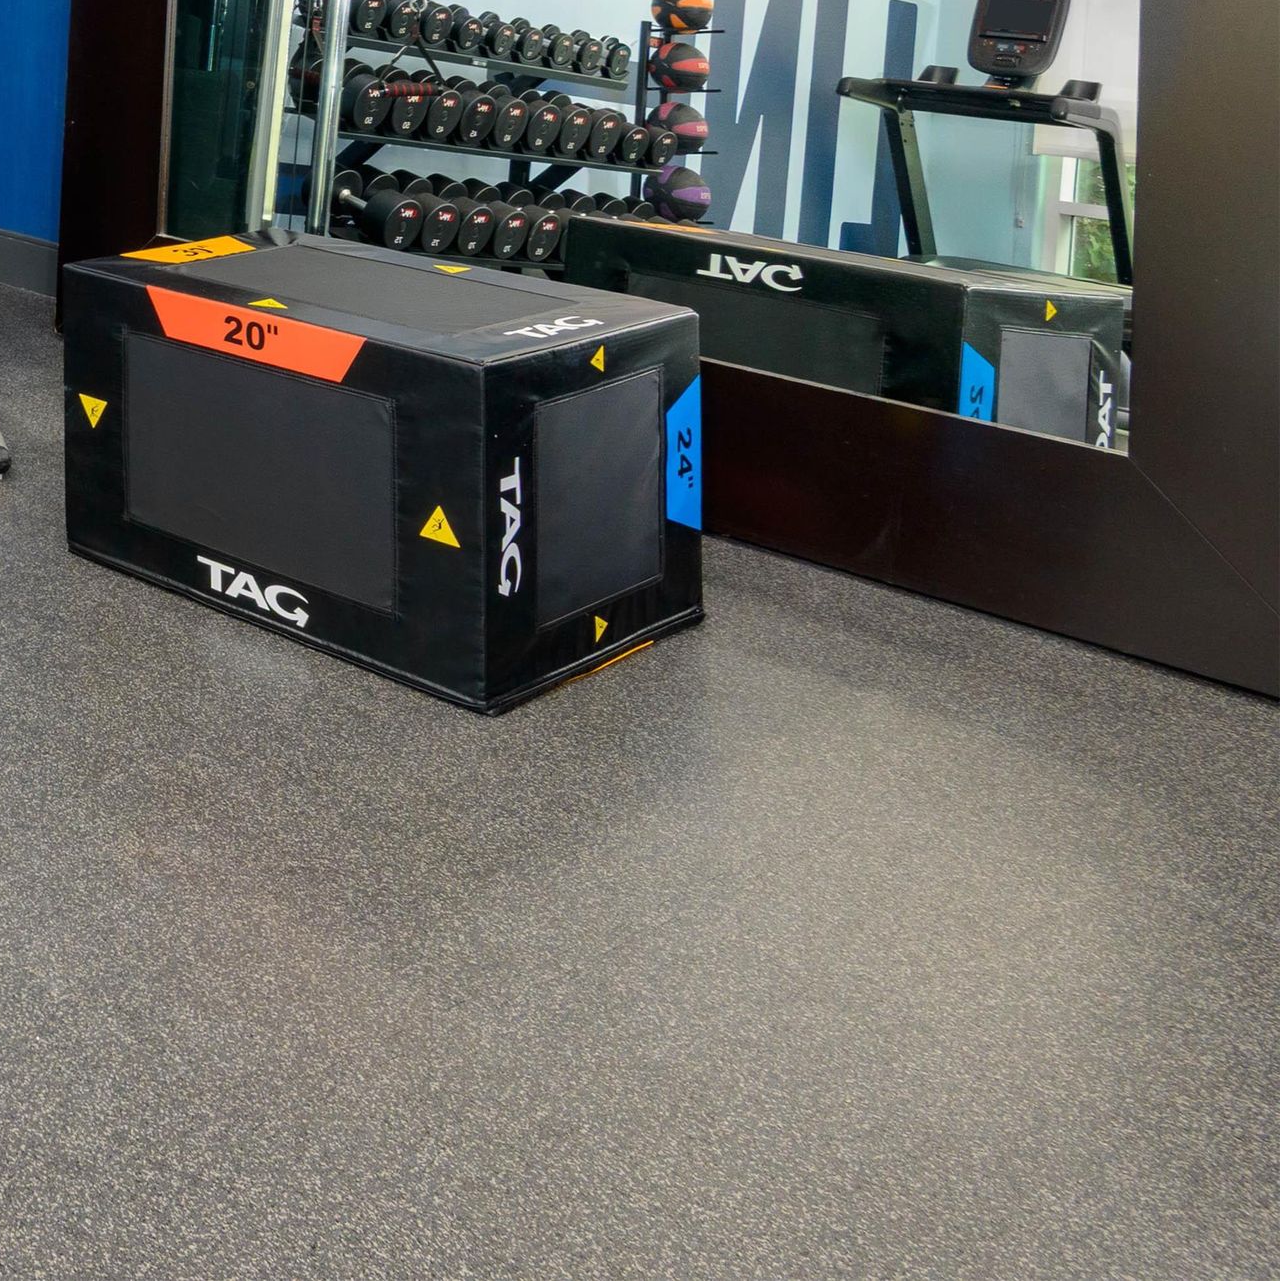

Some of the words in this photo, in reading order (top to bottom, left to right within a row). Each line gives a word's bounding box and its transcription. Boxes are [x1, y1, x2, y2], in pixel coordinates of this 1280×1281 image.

[223, 315, 279, 351] 20"
[503, 315, 605, 339] TAG
[677, 428, 694, 489] 24"
[497, 456, 522, 597] TAG
[197, 555, 309, 628] TAG
